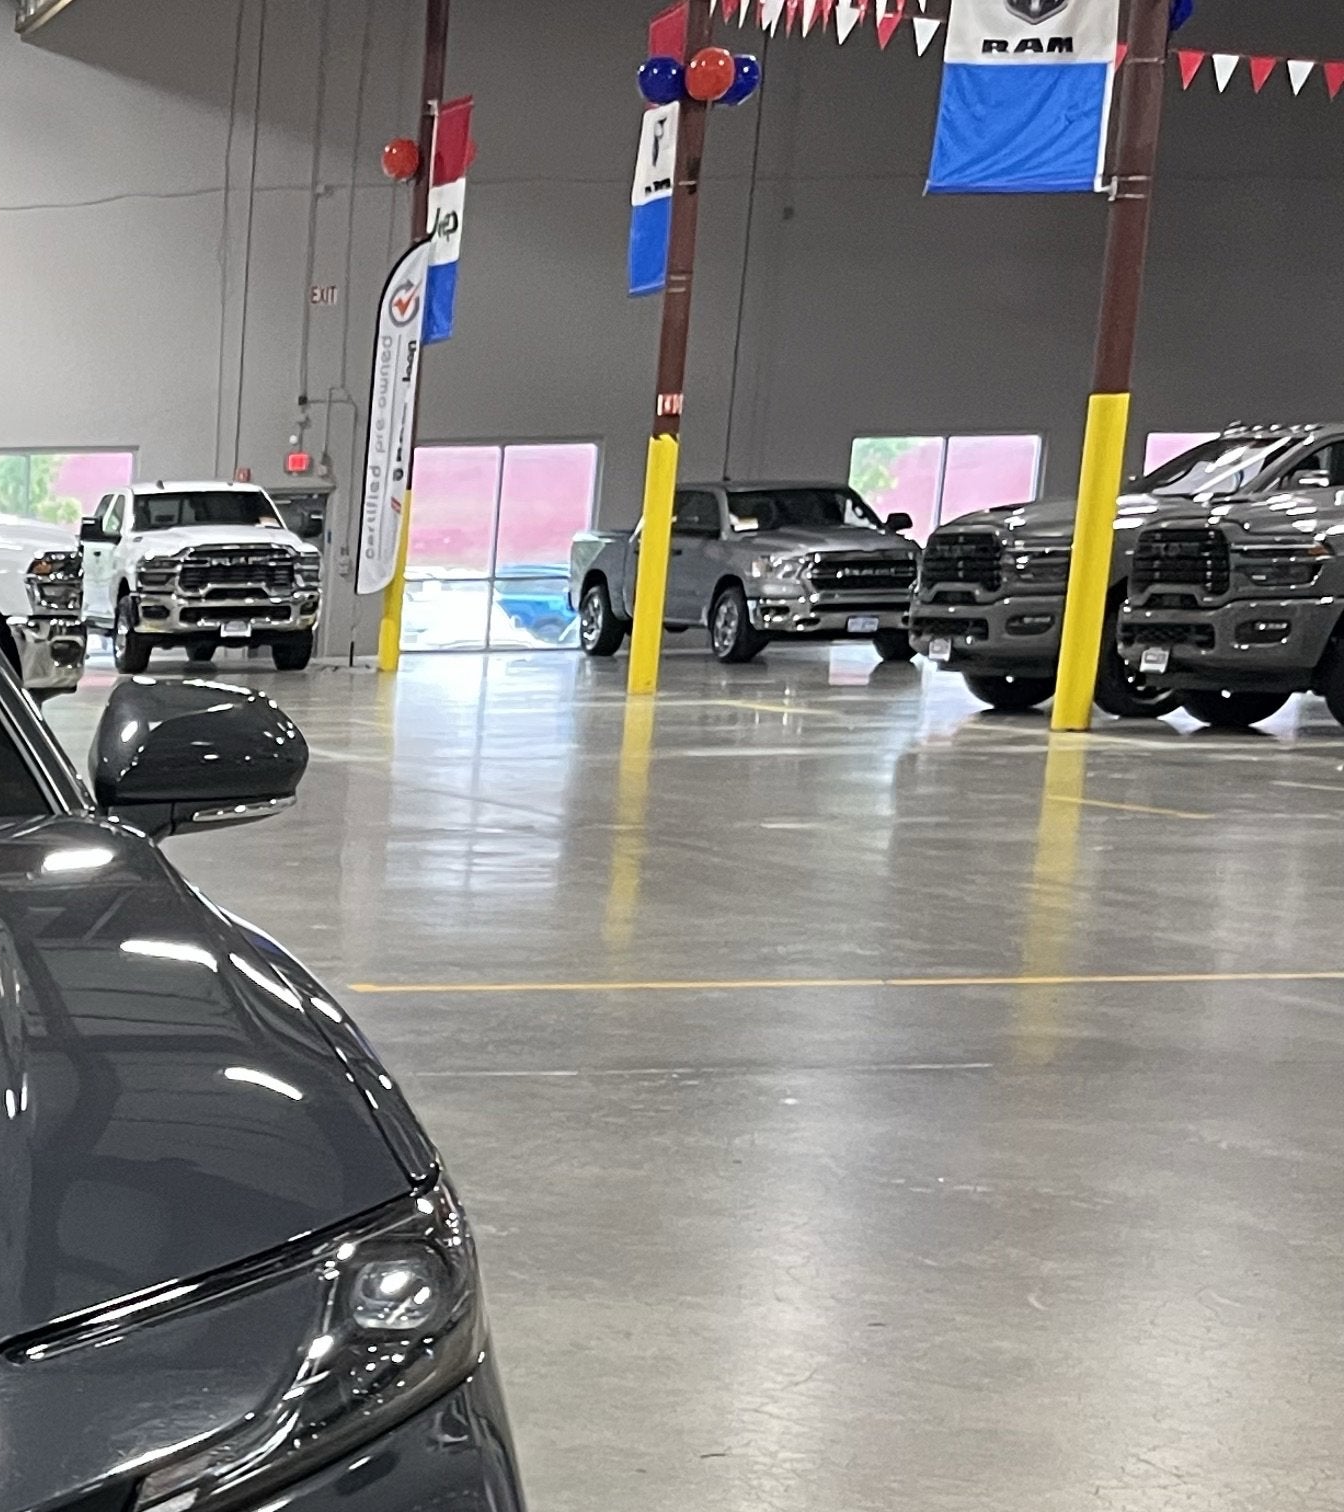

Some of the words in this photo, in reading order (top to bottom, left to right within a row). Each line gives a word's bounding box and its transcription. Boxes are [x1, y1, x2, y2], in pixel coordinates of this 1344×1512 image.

[981, 36, 1073, 54] RAM
[310, 285, 338, 305] EXIT
[364, 464, 381, 560] certified
